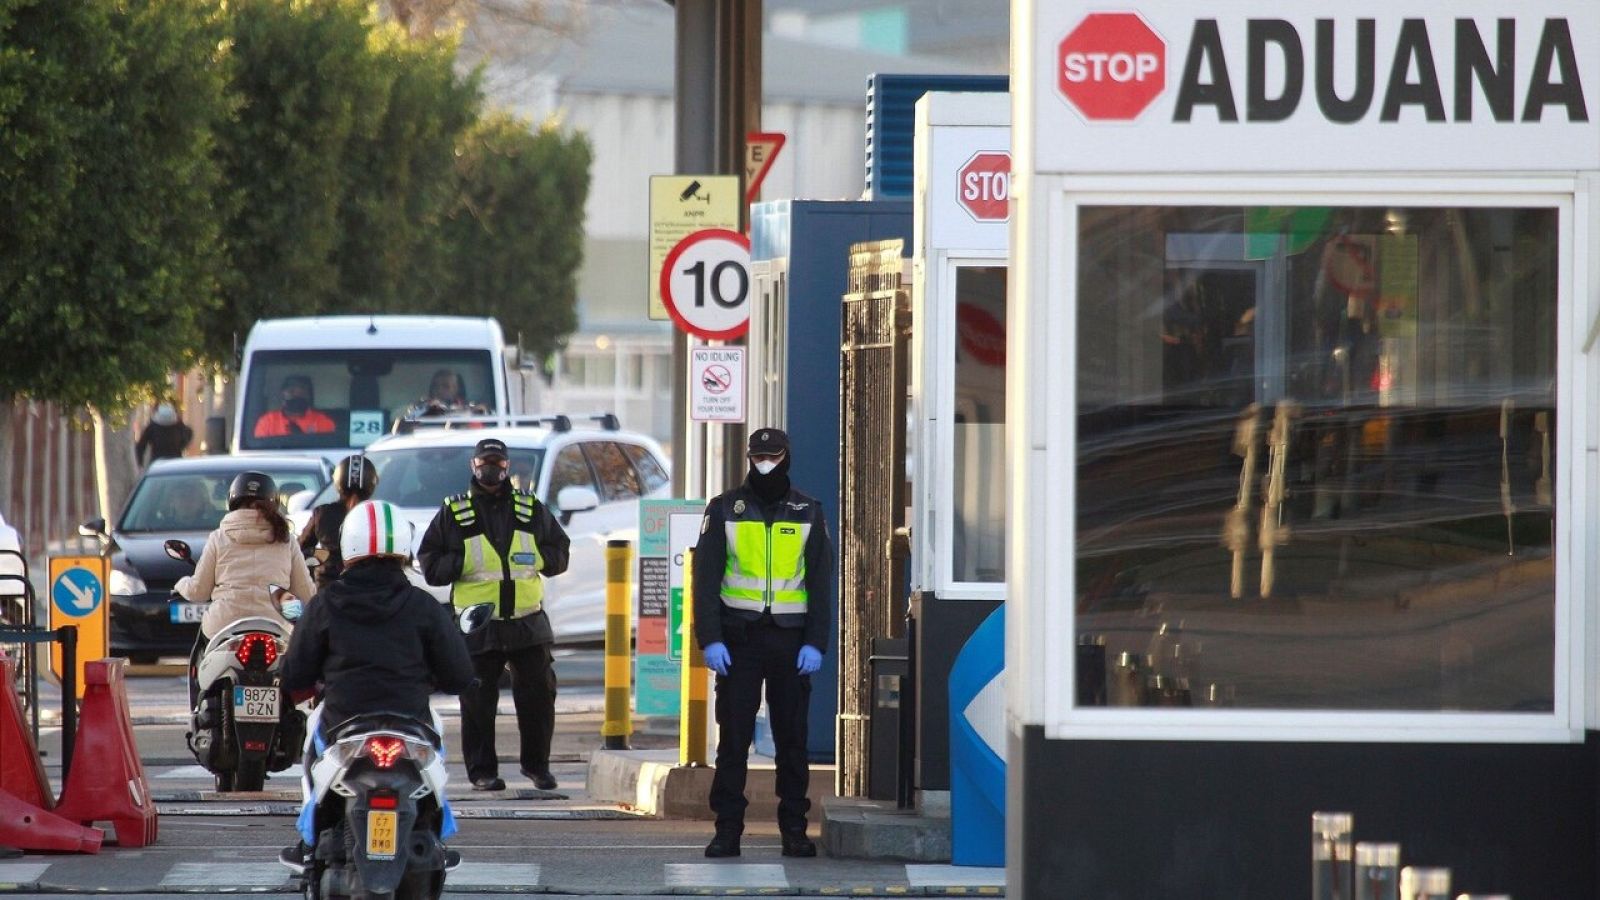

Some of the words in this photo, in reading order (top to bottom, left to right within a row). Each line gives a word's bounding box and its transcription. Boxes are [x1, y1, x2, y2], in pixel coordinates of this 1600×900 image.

[1064, 52, 1159, 83] STOP
[1172, 17, 1590, 125] ADUANA
[683, 260, 749, 310] 10
[695, 351, 708, 362] NO
[709, 351, 740, 362] IDLING
[703, 396, 718, 404] TURN
[352, 420, 380, 434] 28
[244, 688, 276, 702] 9873
[247, 702, 274, 716] GZN
